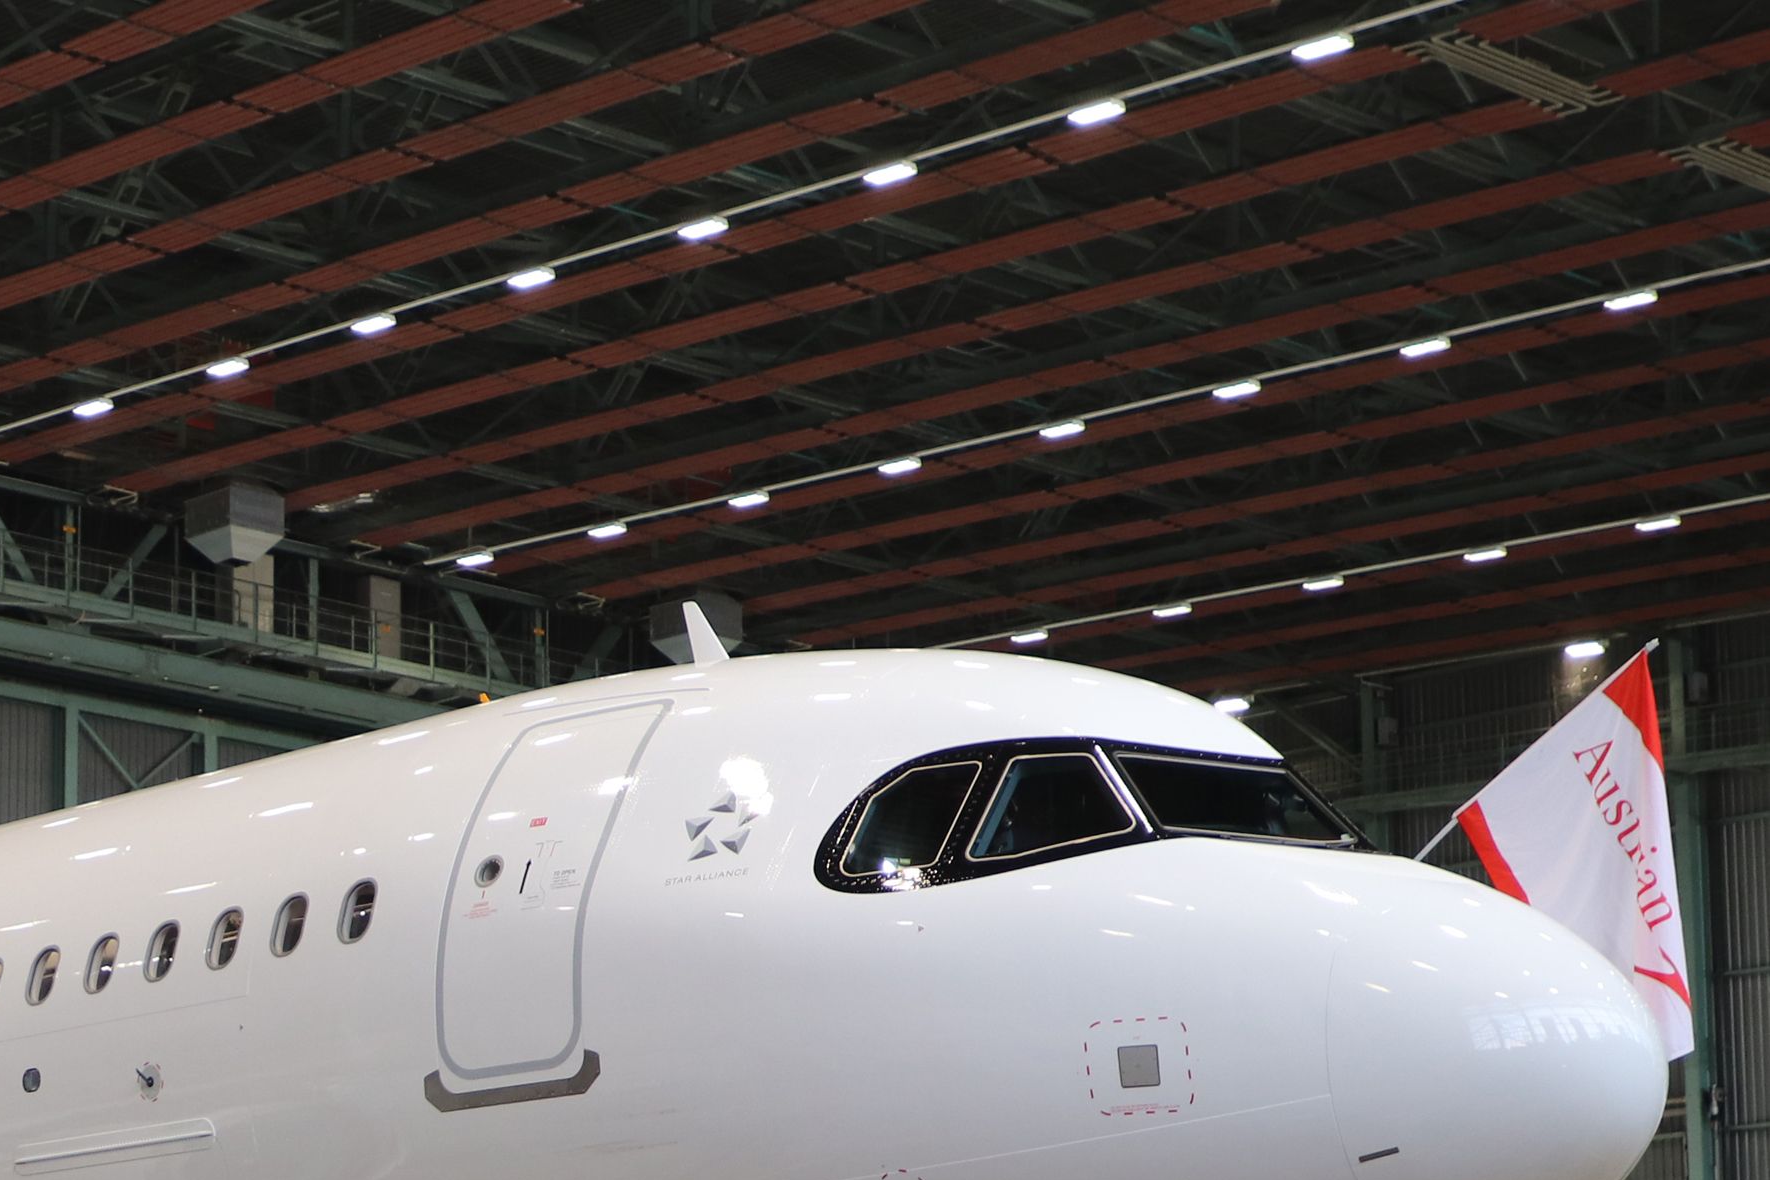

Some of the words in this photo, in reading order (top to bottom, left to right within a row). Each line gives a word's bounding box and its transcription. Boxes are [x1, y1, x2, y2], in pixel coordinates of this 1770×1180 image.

[664, 875, 692, 887] STAR
[693, 867, 749, 882] ALLIANCE
[1573, 740, 1673, 932] Austran
